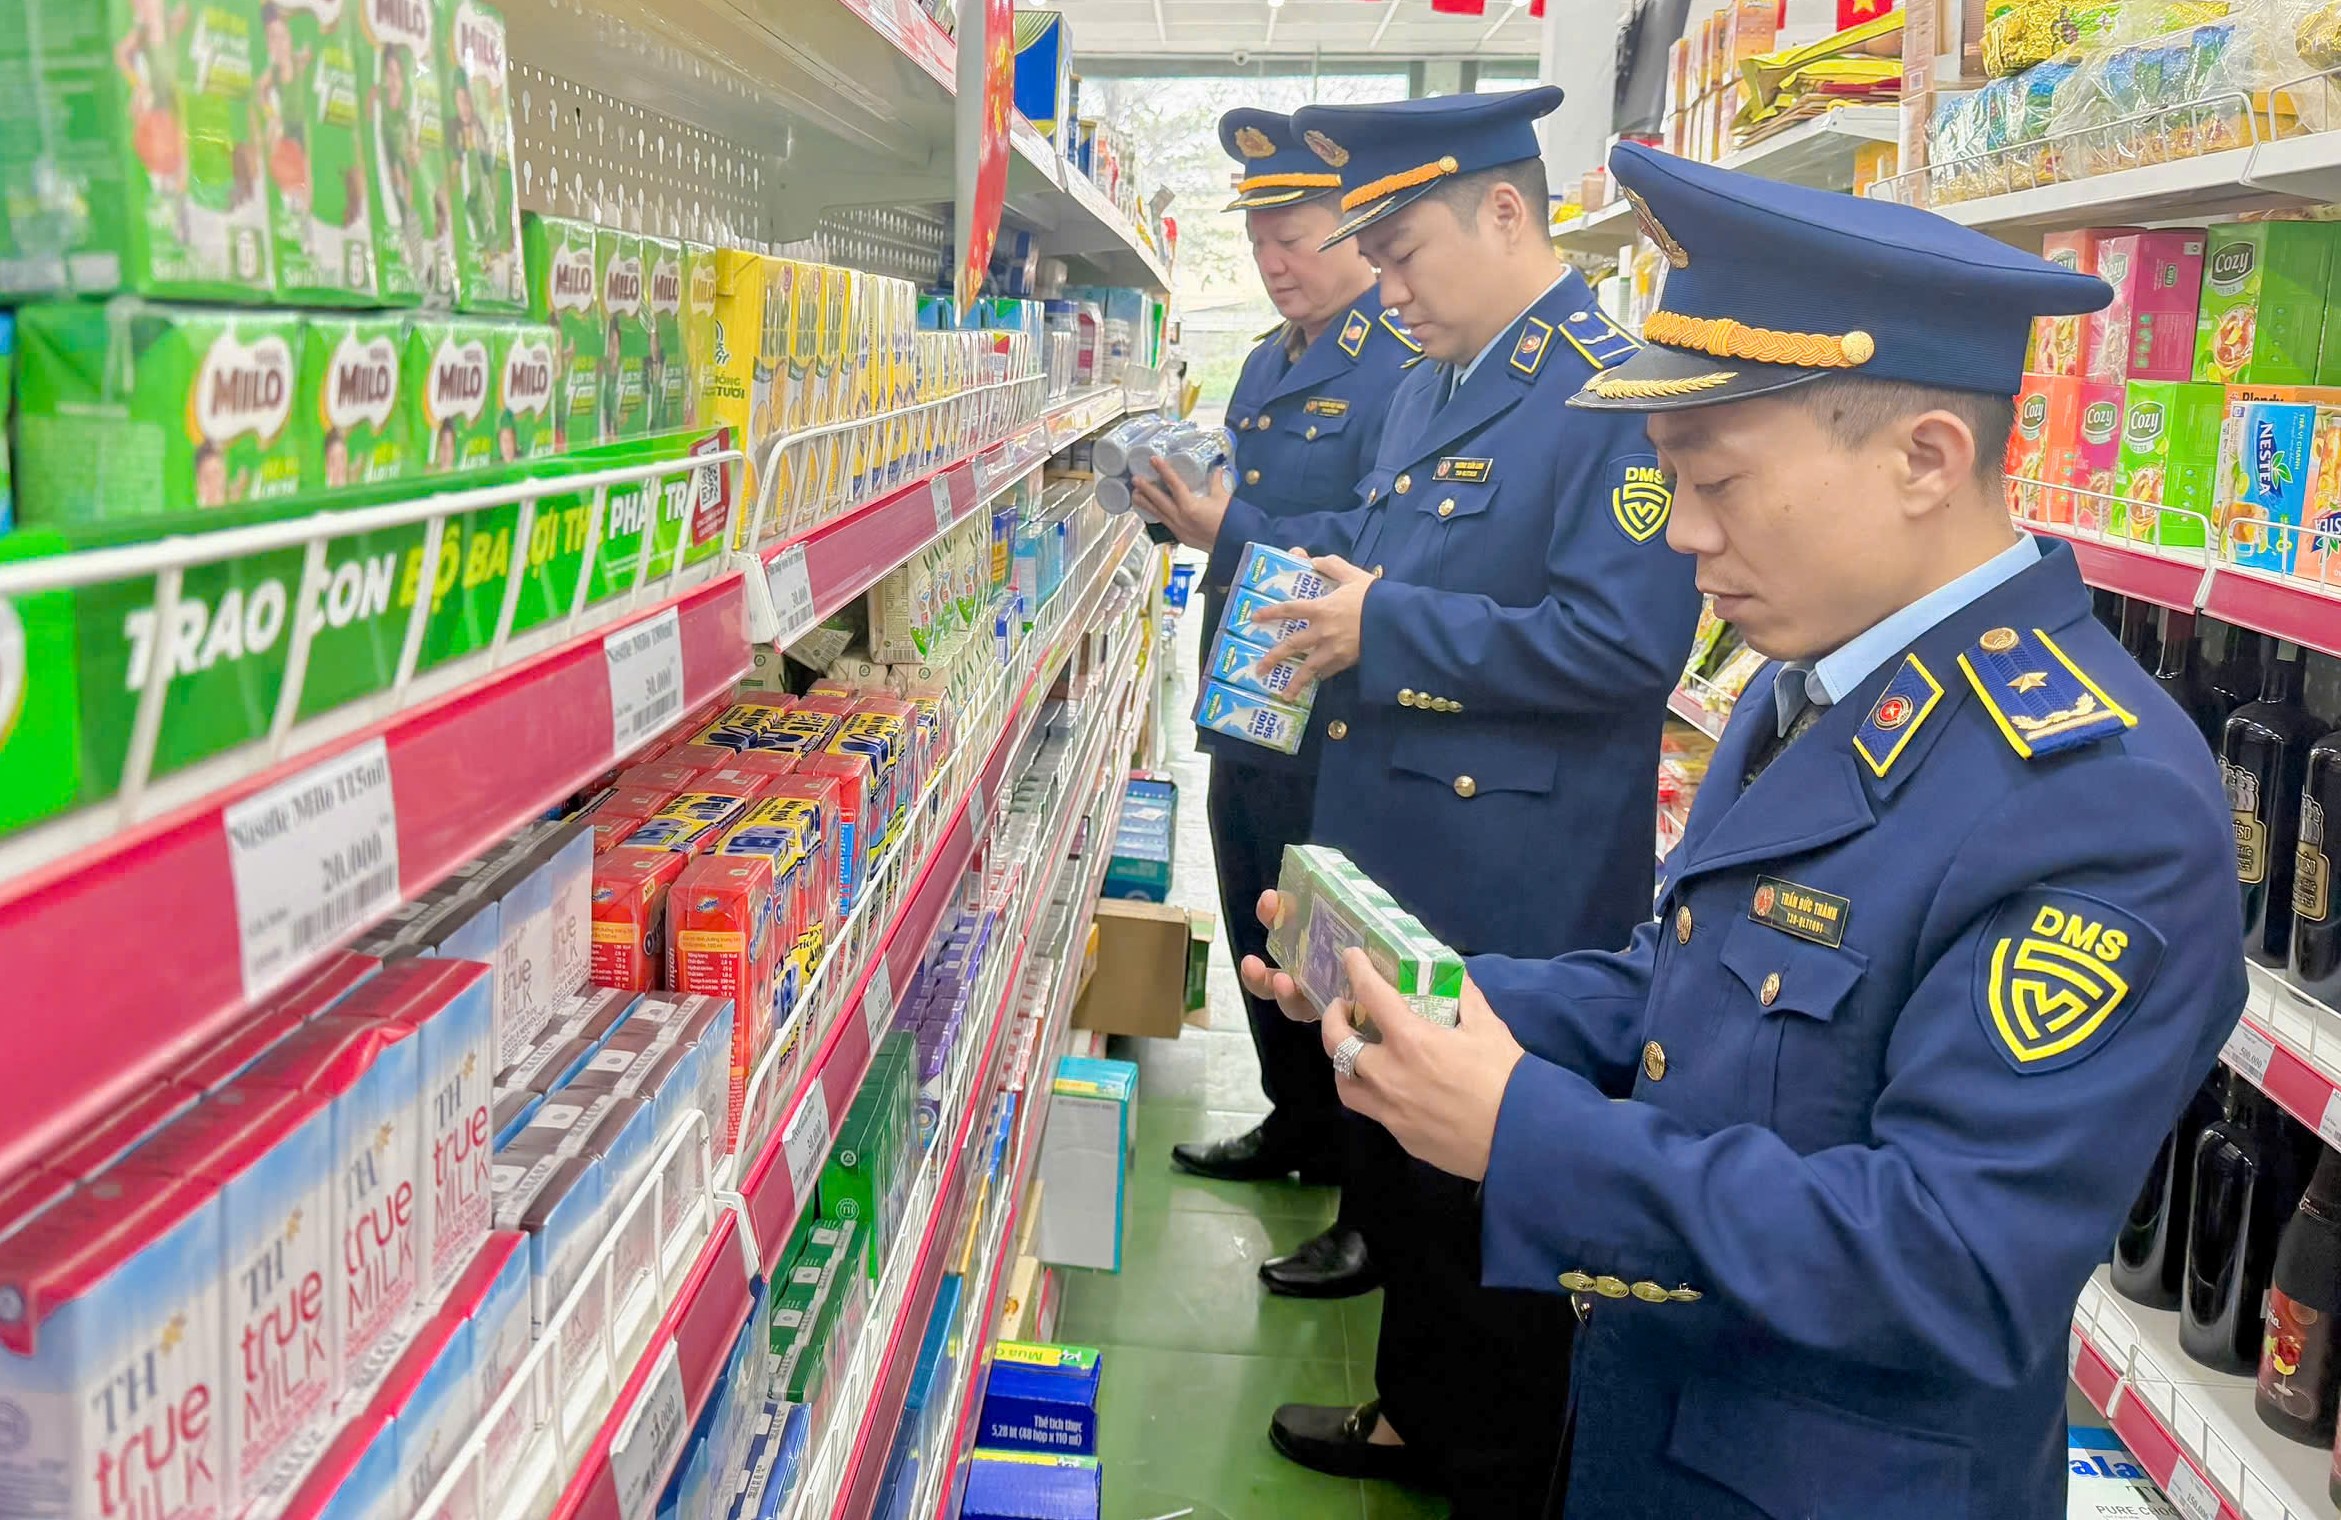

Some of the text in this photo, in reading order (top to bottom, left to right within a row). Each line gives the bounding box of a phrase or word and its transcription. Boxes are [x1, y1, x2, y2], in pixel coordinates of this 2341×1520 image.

[555, 264, 592, 295] MILO
[2215, 251, 2249, 272] Cozy
[607, 273, 639, 300] MILO
[653, 275, 679, 301] MILO
[211, 367, 283, 417] MILO
[338, 363, 390, 408] MILO
[437, 363, 481, 401] MILO
[509, 363, 548, 399] MILO
[2024, 402, 2044, 421] Cozy
[2087, 409, 2113, 426] Cozy
[2131, 411, 2159, 432] Cozy
[1625, 467, 1666, 485] DMS
[2258, 423, 2274, 496] NESTEA
[124, 578, 287, 692] TRAO
[462, 528, 509, 590] BA
[609, 477, 662, 540] PHÁ
[1254, 710, 1270, 737] TƯƠI
[1264, 713, 1278, 739] SẠCH
[2031, 905, 2129, 962] DMS
[502, 957, 532, 1001] true
[436, 1074, 462, 1128] TH
[434, 1105, 488, 1187] true
[345, 1150, 378, 1209] TH
[435, 1143, 489, 1236] MILK
[344, 1181, 413, 1277] true
[242, 1239, 285, 1309] TH
[347, 1209, 415, 1325] MILK
[241, 1271, 323, 1383] true
[1008, 1349, 1043, 1361] Mua
[92, 1350, 157, 1435] TH
[244, 1314, 326, 1442] MILK
[96, 1384, 211, 1517] true
[991, 1424, 1008, 1438] 5,28
[1018, 1427, 1032, 1440] (48
[1033, 1428, 1048, 1444] hộp
[1055, 1431, 1068, 1444] 110
[2095, 1505, 2136, 1515] PURE
